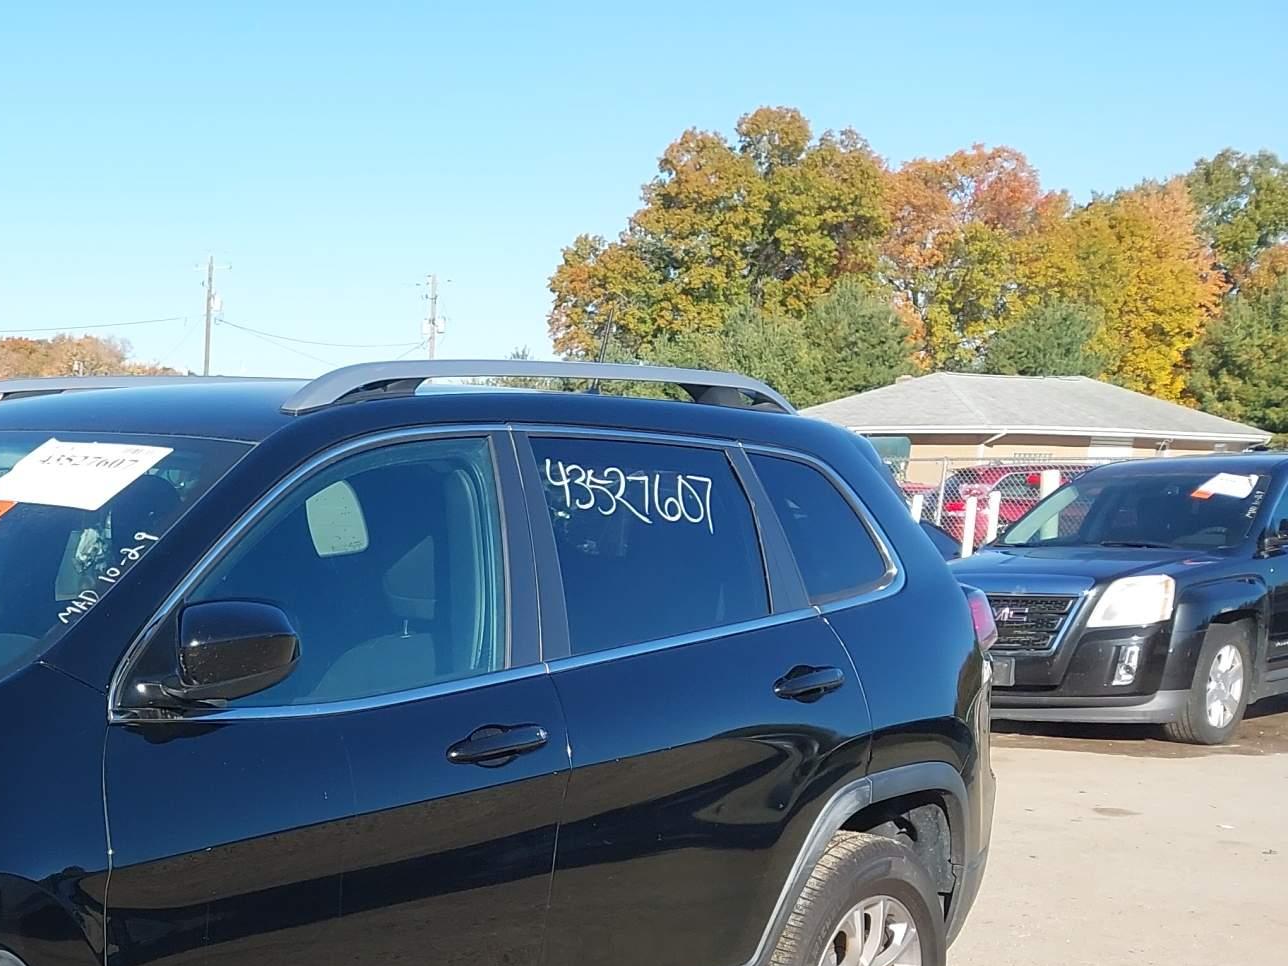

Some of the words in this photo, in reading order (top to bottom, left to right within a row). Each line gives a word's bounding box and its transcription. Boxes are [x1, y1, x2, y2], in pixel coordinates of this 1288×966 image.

[545, 458, 714, 534] 43527607
[58, 590, 100, 624] MAD
[98, 532, 160, 583] 10-29
[992, 606, 1029, 622] MC
